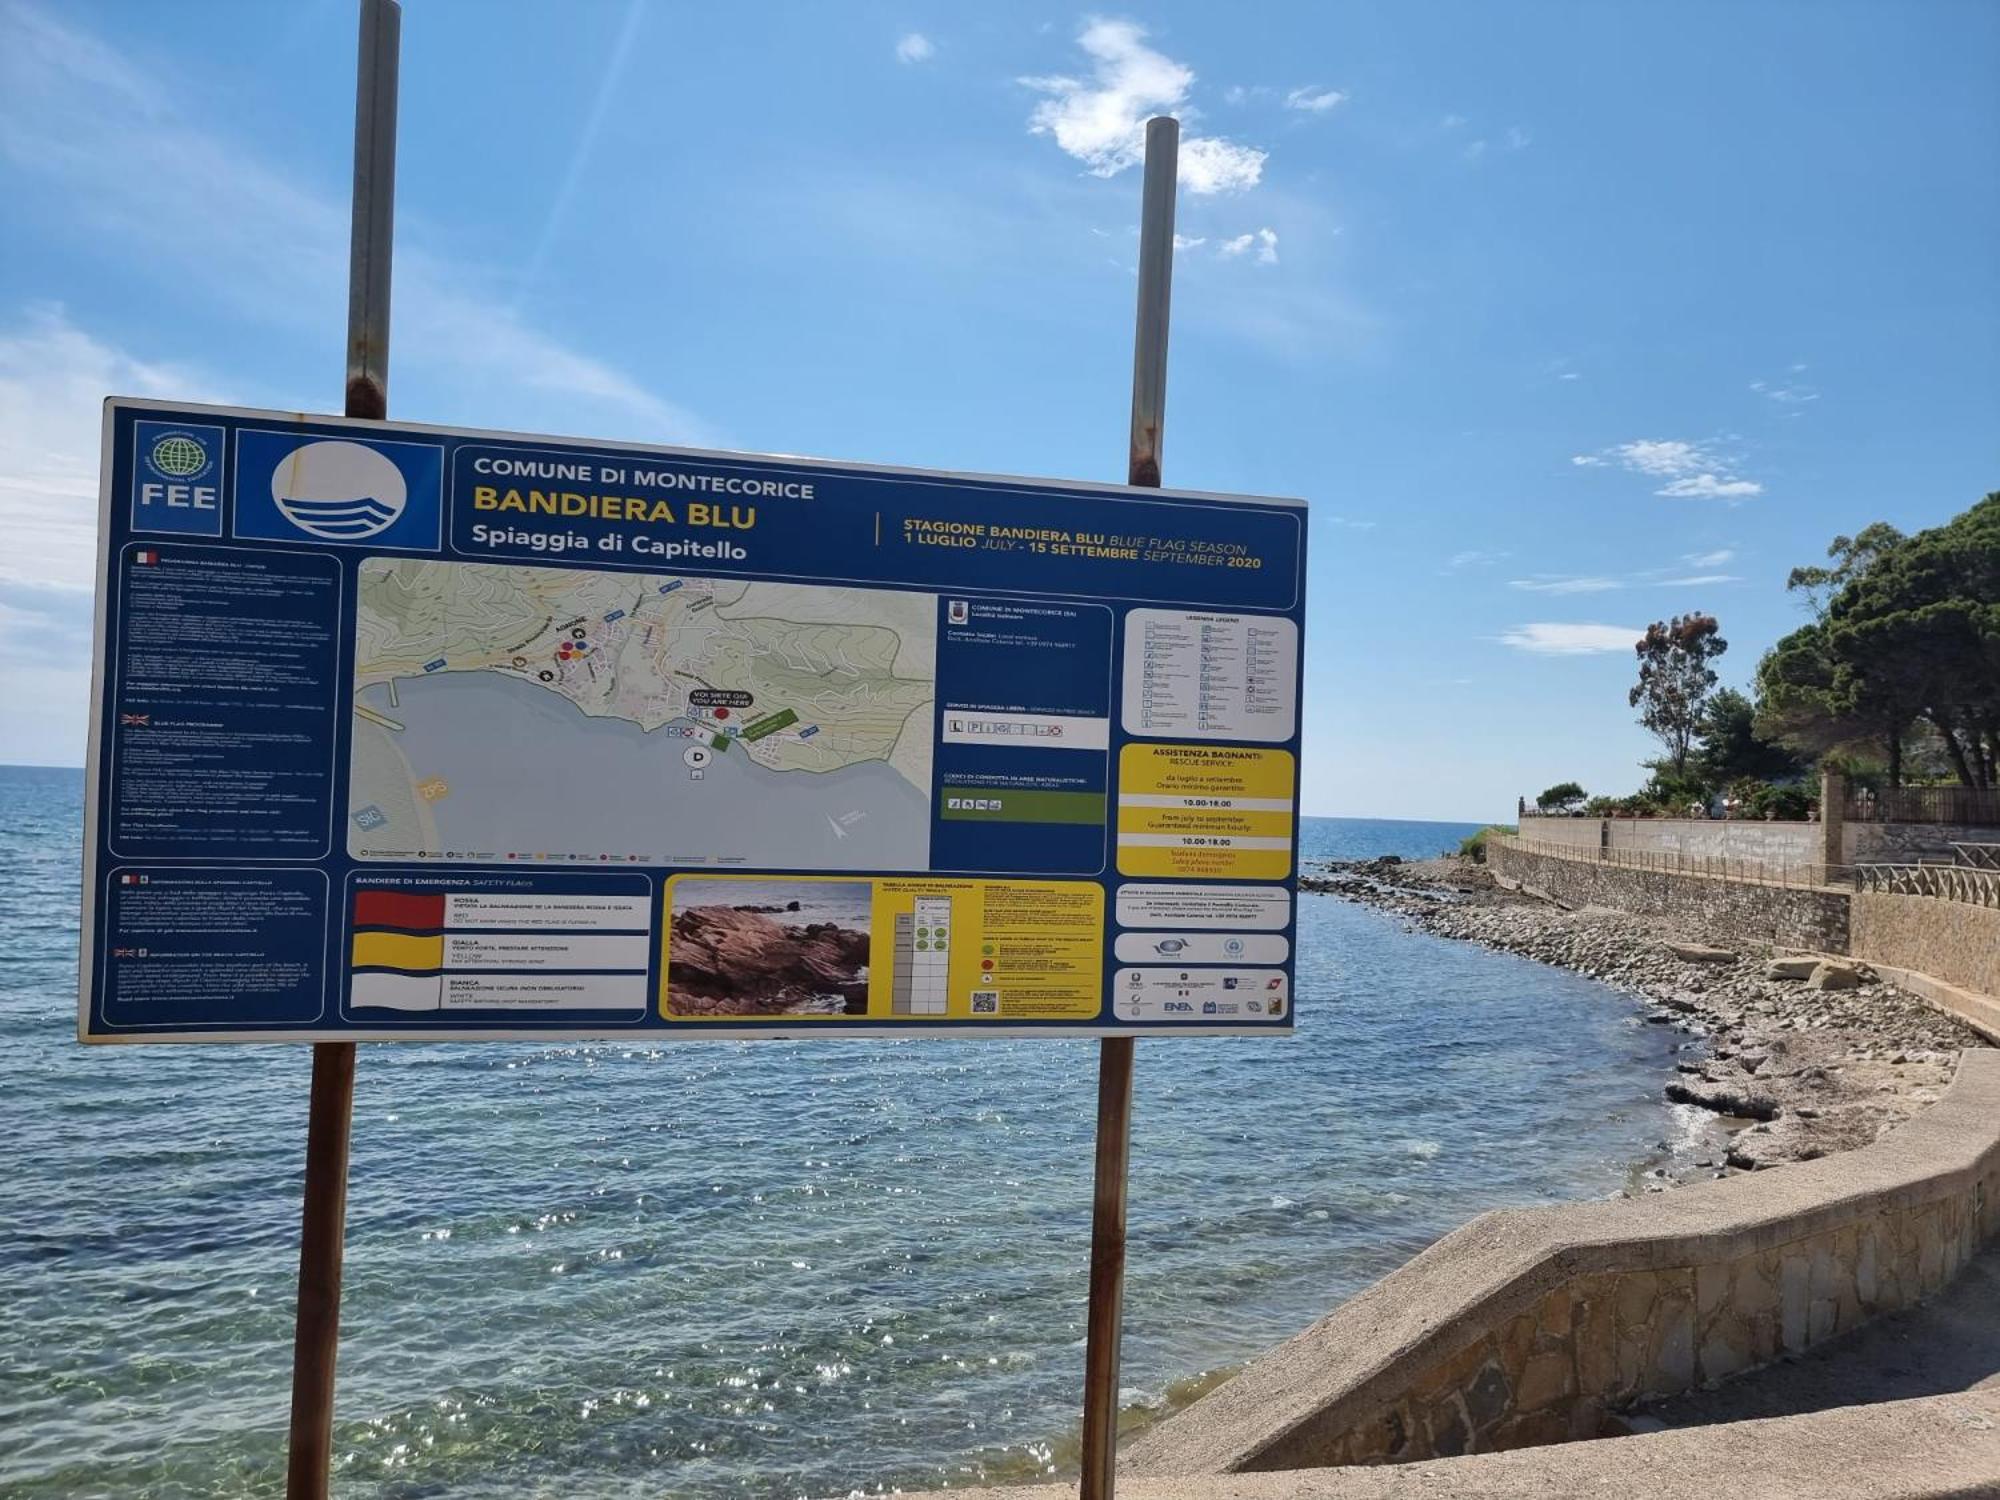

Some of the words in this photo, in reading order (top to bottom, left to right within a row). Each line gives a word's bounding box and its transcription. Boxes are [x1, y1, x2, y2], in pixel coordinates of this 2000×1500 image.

[474, 458, 591, 481] COMUNE
[601, 467, 625, 484] DI
[634, 470, 814, 500] MONTECORICE
[142, 483, 215, 509] FEE
[474, 486, 675, 523] BANDIERA
[688, 503, 755, 529] BLU
[472, 525, 588, 552] Spiaggia
[598, 534, 622, 551] di
[632, 535, 746, 560] Capitello
[904, 519, 985, 536] STAGIONE
[990, 526, 1070, 543] BANDIERA
[1075, 531, 1104, 545] BLU
[1110, 534, 1146, 548] BLUE
[1149, 537, 1186, 551] FLAG
[1189, 540, 1248, 556] SEASON
[904, 533, 911, 543] 1
[918, 533, 977, 548] LUGLIO
[981, 537, 1016, 551] JULY
[1029, 542, 1046, 553] 15
[1051, 543, 1138, 560] SETTEMBRE
[1143, 549, 1225, 566] SEPTEMBER
[1227, 555, 1261, 568] 2020
[694, 752, 704, 761] D
[1153, 749, 1209, 758] ASSISTENZA
[1170, 758, 1200, 766] RESCUE
[358, 809, 381, 826] SIC
[1164, 1002, 1194, 1011] ENEA
